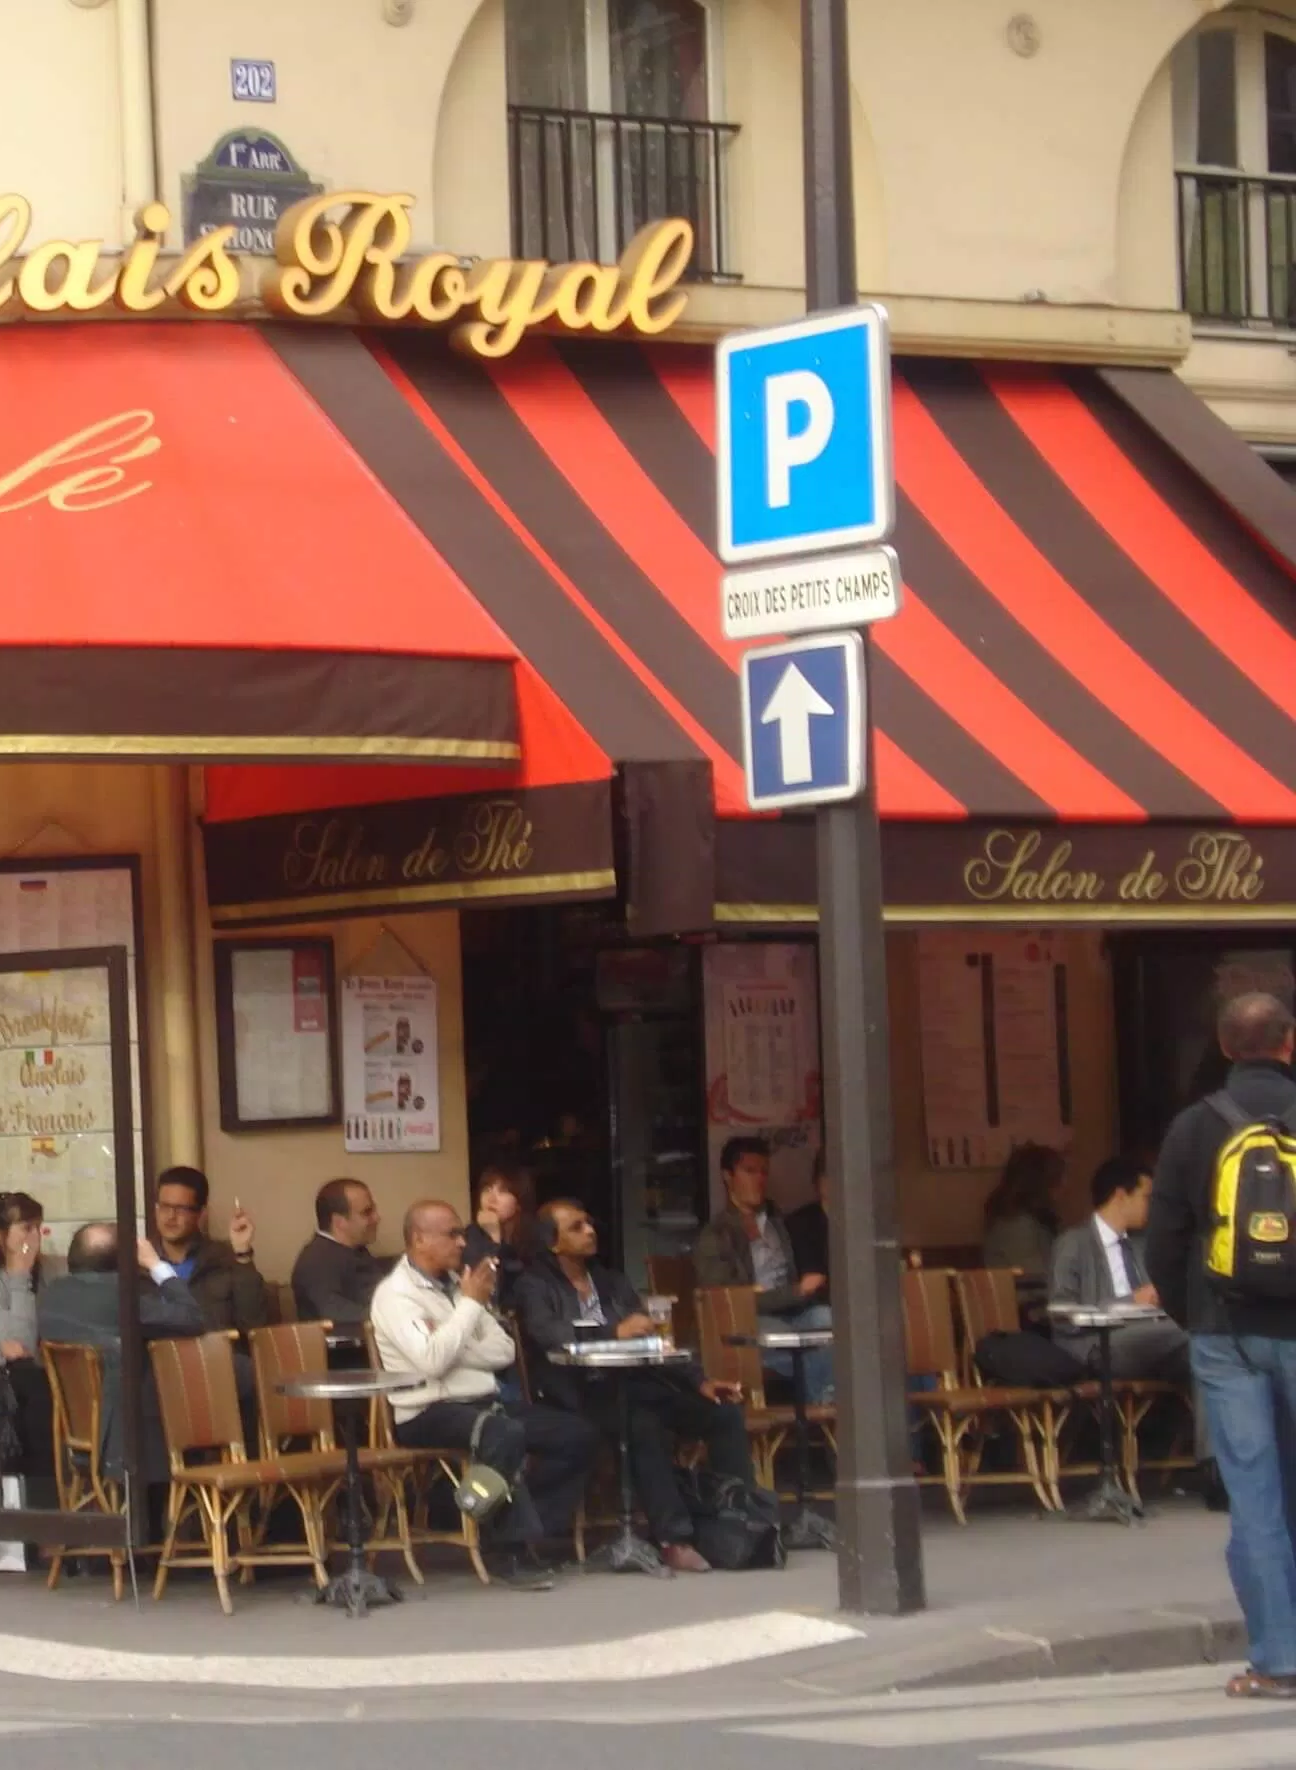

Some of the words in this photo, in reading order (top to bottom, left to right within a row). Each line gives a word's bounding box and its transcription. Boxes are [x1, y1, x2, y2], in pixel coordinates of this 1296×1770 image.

[234, 63, 274, 98] 202
[230, 191, 277, 220] RUE
[278, 190, 694, 358] Royal
[765, 369, 835, 509] P
[727, 591, 761, 620] CROIX
[765, 585, 787, 614] DES
[791, 579, 831, 610] PETITS
[835, 570, 891, 603] CHAMPS
[283, 819, 386, 888] Salon
[402, 828, 449, 878] de
[456, 800, 534, 874] Thé
[963, 828, 1105, 900] Salon
[1119, 849, 1169, 900] de
[1174, 831, 1265, 900] Thé
